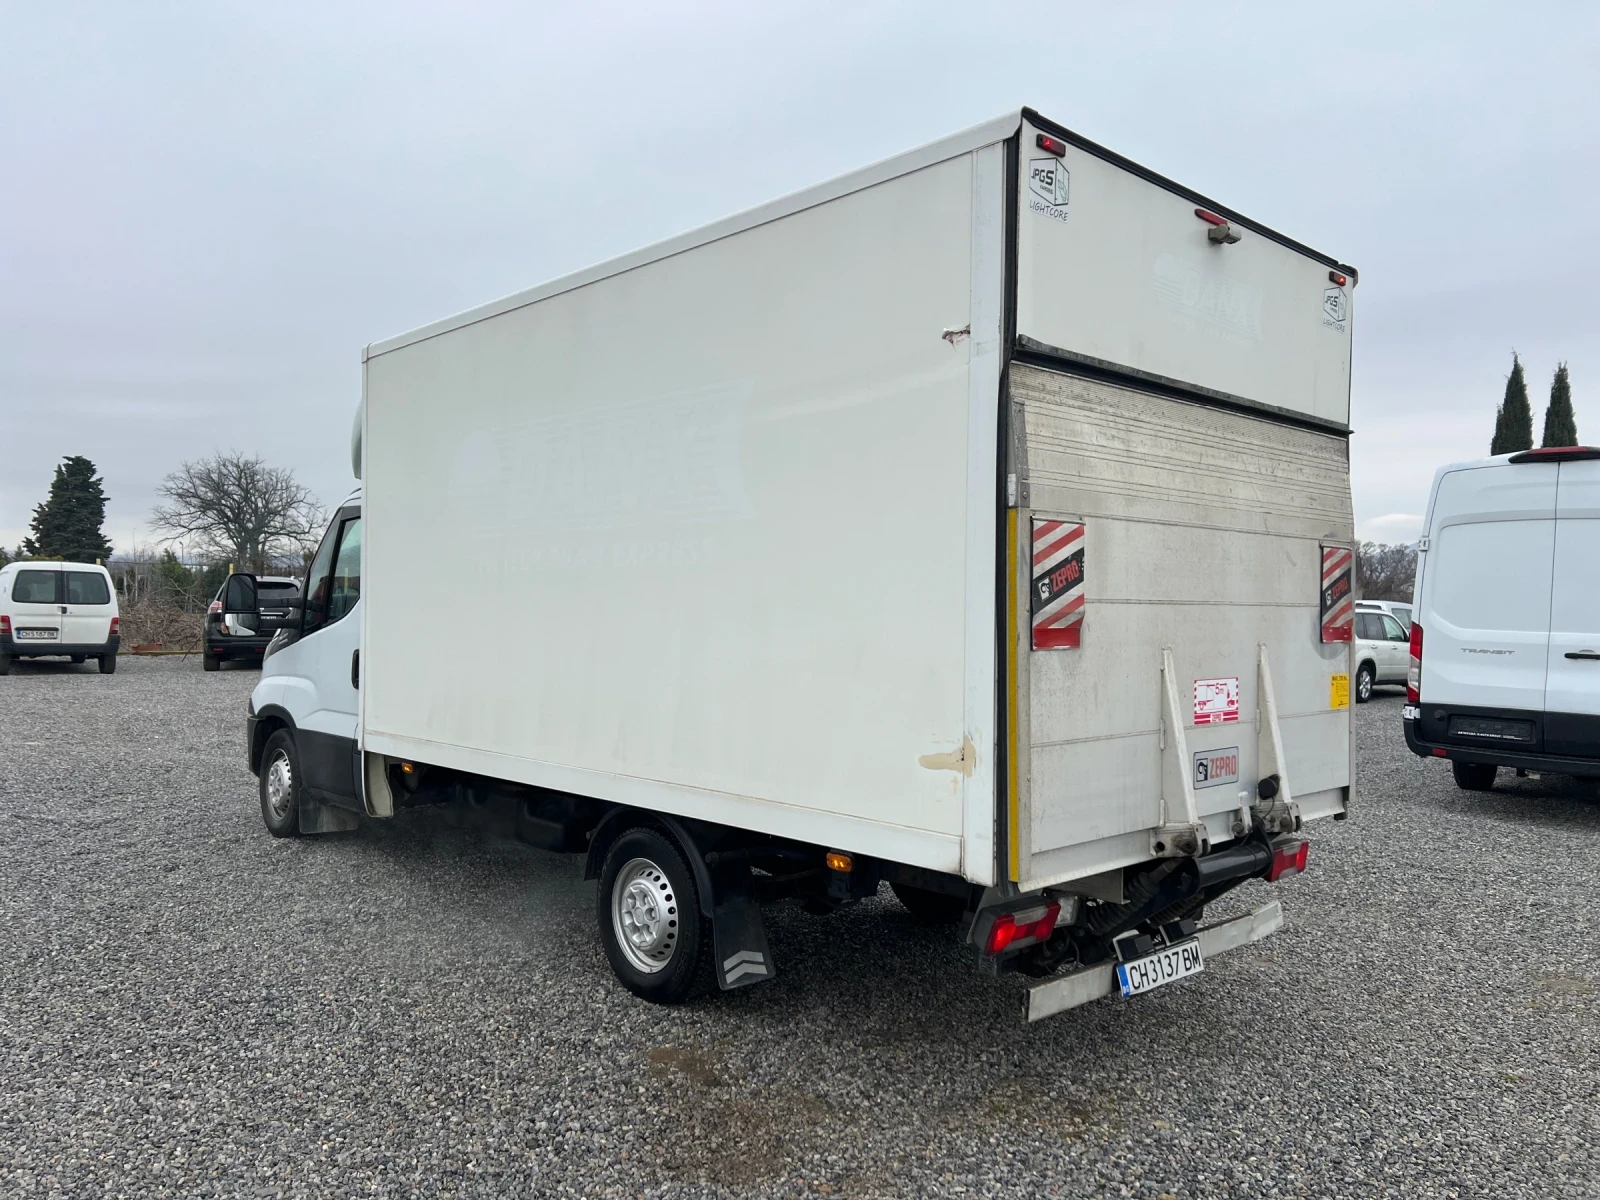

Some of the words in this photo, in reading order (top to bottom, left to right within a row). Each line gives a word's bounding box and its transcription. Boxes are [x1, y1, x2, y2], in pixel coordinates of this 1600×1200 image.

[1031, 168, 1054, 186] JPGS
[1030, 200, 1068, 221] LIGHTCORE
[1050, 559, 1080, 593] ZEPRO
[1331, 576, 1349, 600] ZEPRO
[1460, 648, 1515, 656] TRANSIT
[1209, 754, 1237, 780] ZEPRO
[1122, 985, 1130, 994] BG
